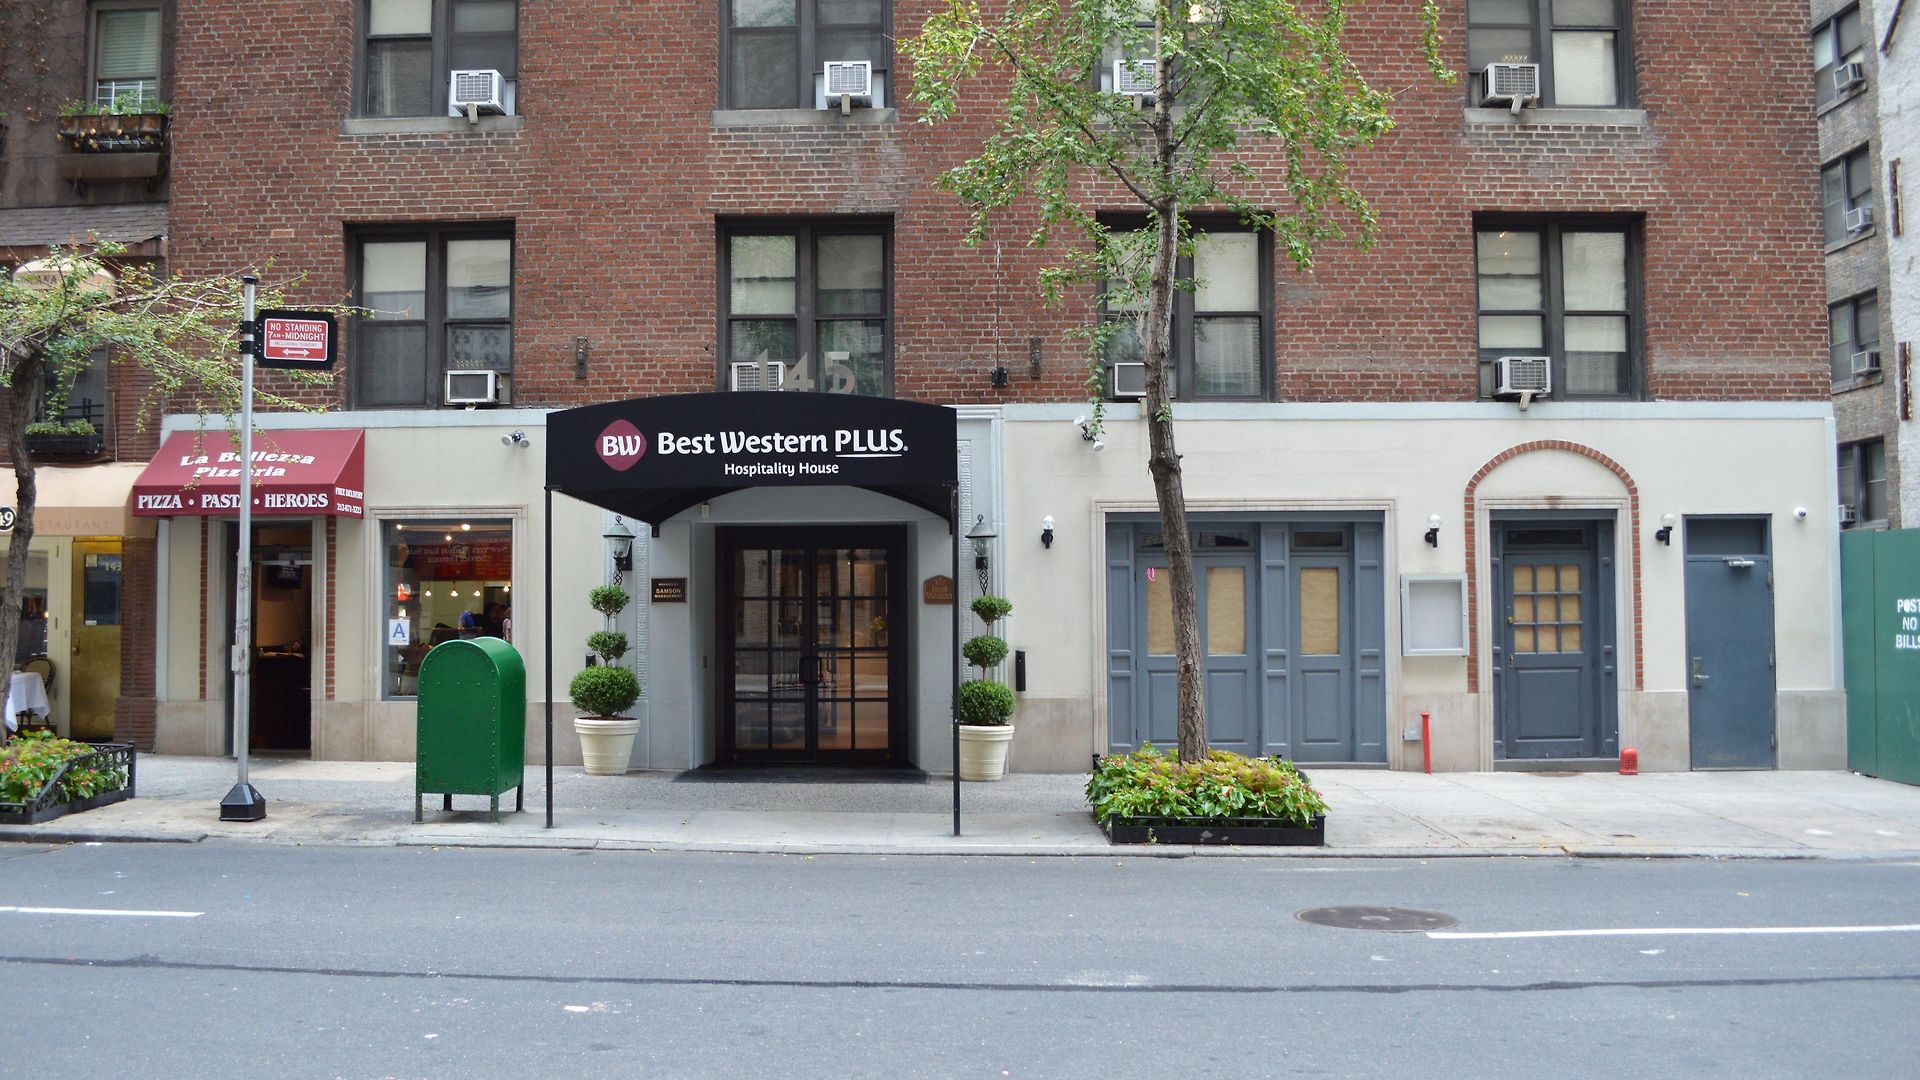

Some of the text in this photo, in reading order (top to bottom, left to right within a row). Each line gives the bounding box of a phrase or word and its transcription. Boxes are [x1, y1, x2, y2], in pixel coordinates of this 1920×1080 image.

[270, 322, 323, 333] NO STANDING
[756, 348, 855, 394] 145
[602, 435, 641, 457] BW
[657, 432, 716, 455] Best
[719, 431, 828, 454] Western
[180, 455, 209, 466] La
[724, 462, 839, 477] Hospitality House
[138, 493, 329, 509] PIZZA PAST HEROES
[392, 623, 406, 638] A
[1902, 616, 1917, 631] NO
